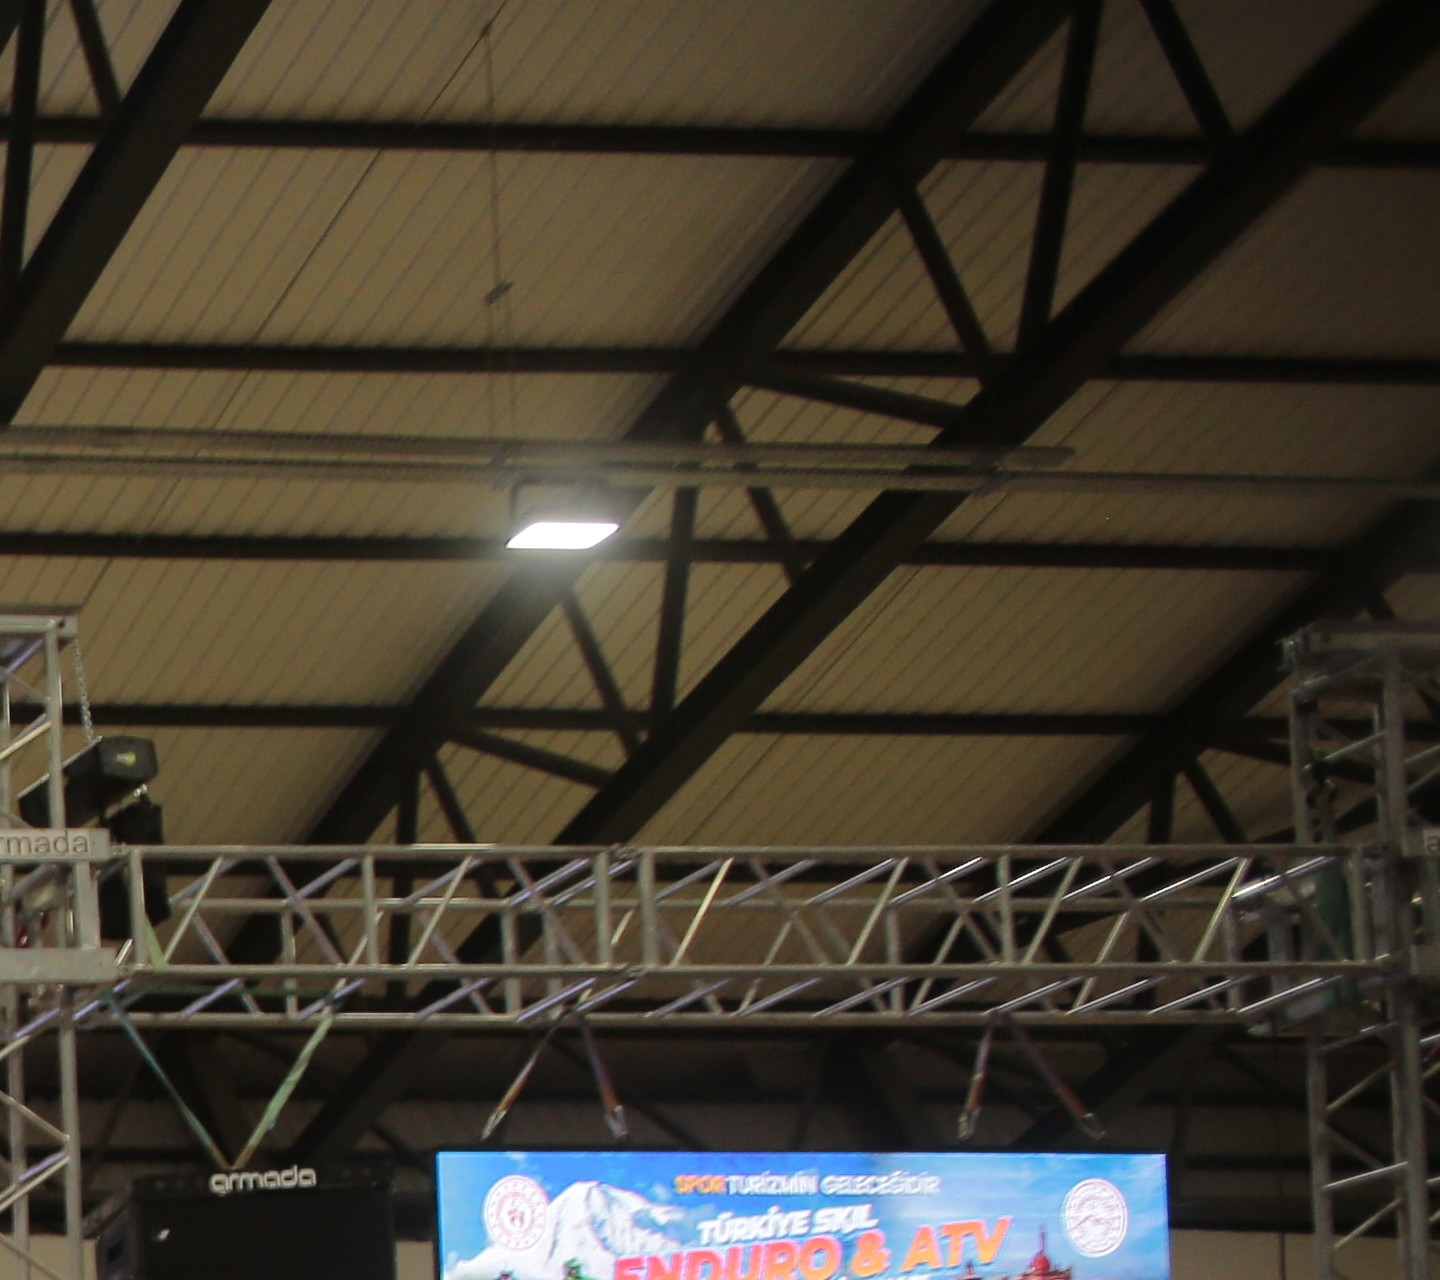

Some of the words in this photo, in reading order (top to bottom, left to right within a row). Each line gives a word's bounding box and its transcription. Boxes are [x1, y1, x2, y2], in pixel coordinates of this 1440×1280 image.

[210, 1165, 317, 1194] armada
[697, 1206, 812, 1247] TÜRKİYE
[814, 1203, 879, 1234] SKIL
[851, 1229, 888, 1277] &
[903, 1216, 1013, 1271] ATV
